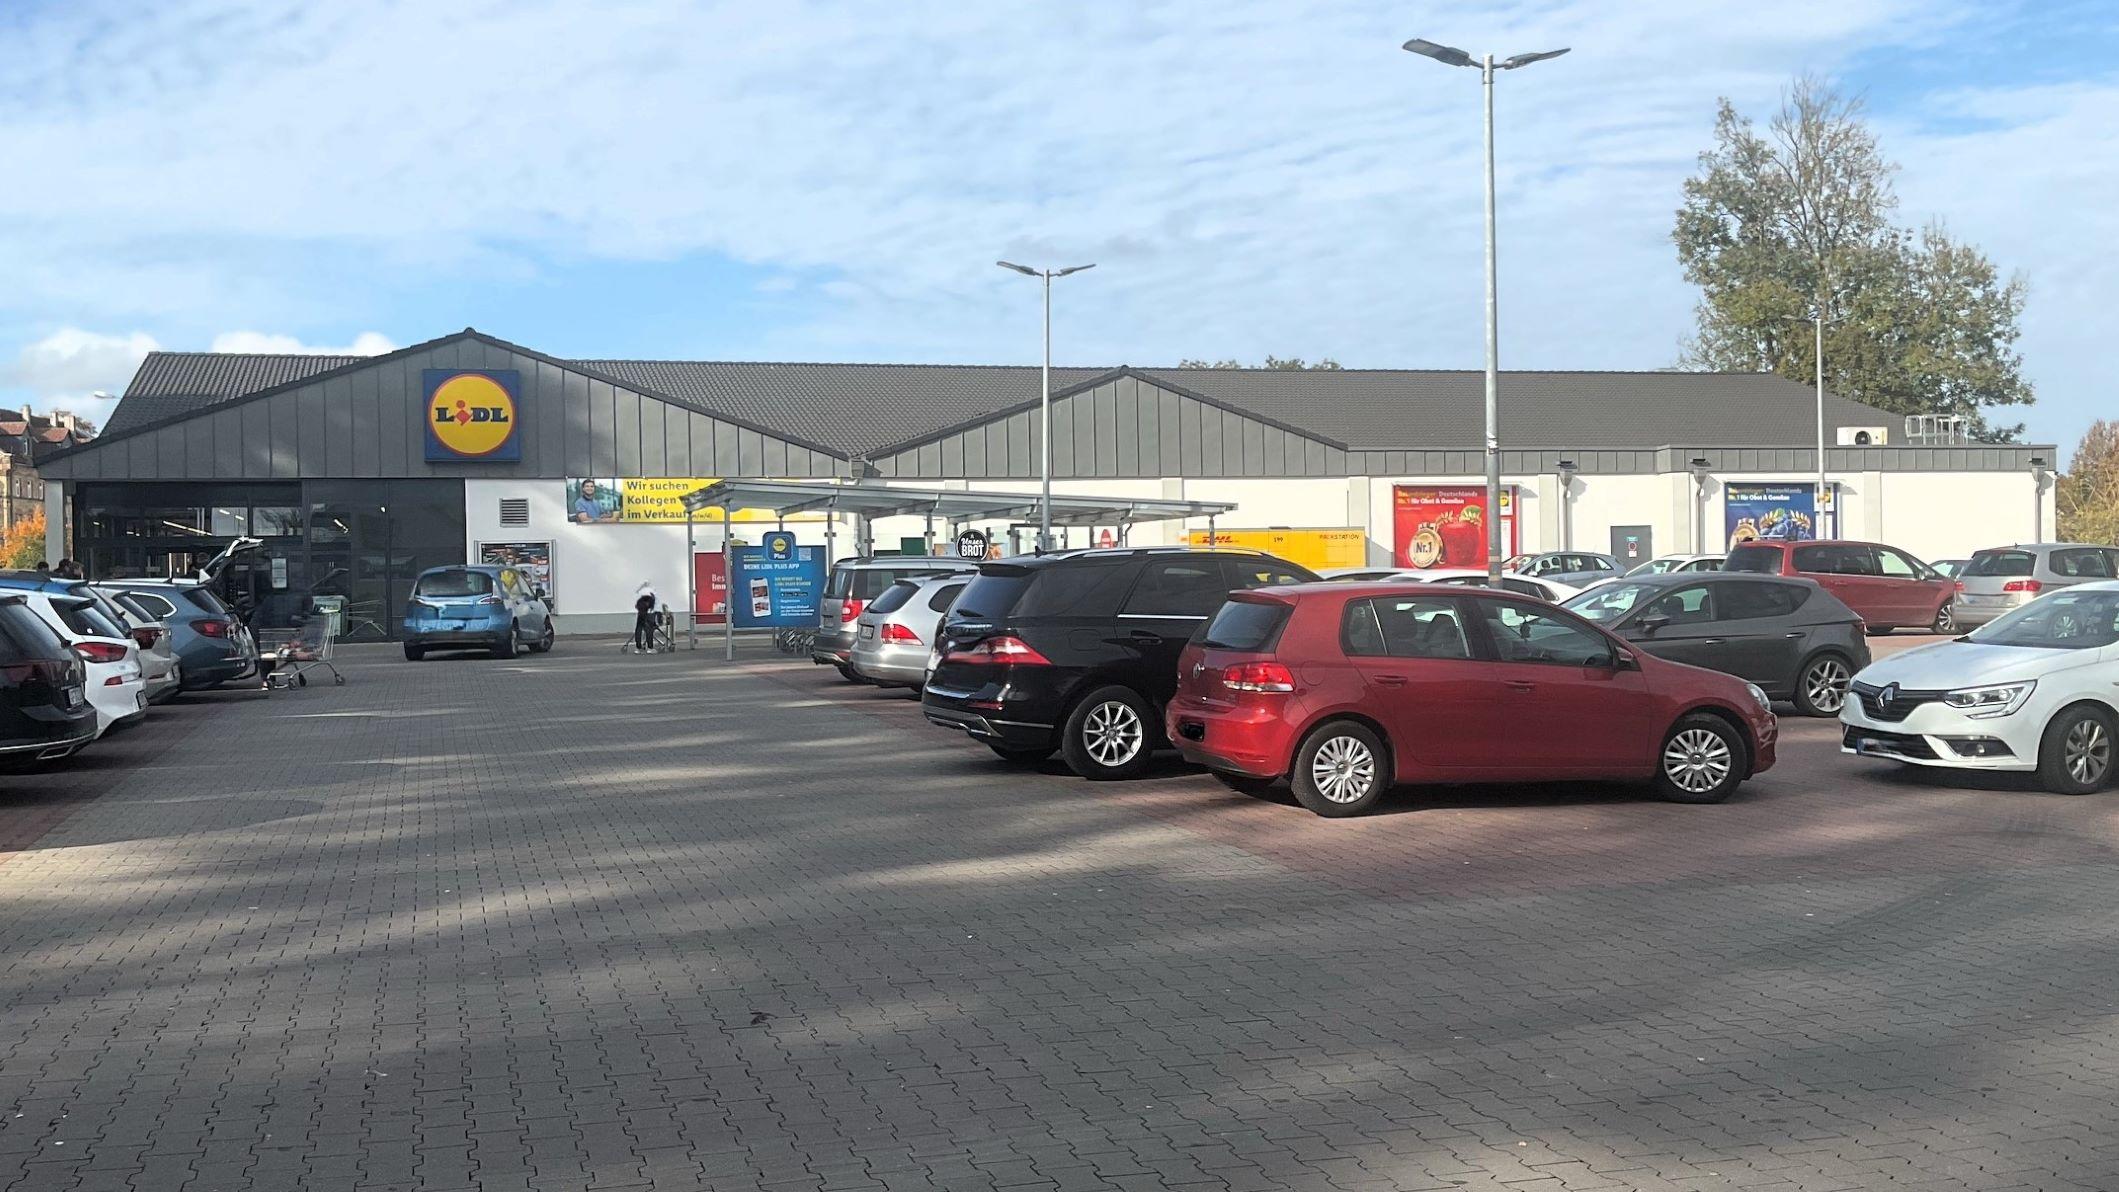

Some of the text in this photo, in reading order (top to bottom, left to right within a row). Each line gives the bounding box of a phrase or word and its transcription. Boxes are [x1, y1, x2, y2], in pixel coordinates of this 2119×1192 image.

[435, 400, 509, 426] LIDL
[627, 481, 689, 490] Wir suchen
[627, 496, 677, 506] Kollegen
[627, 509, 641, 519] im
[644, 509, 687, 519] Verkauf
[961, 545, 984, 557] BROT
